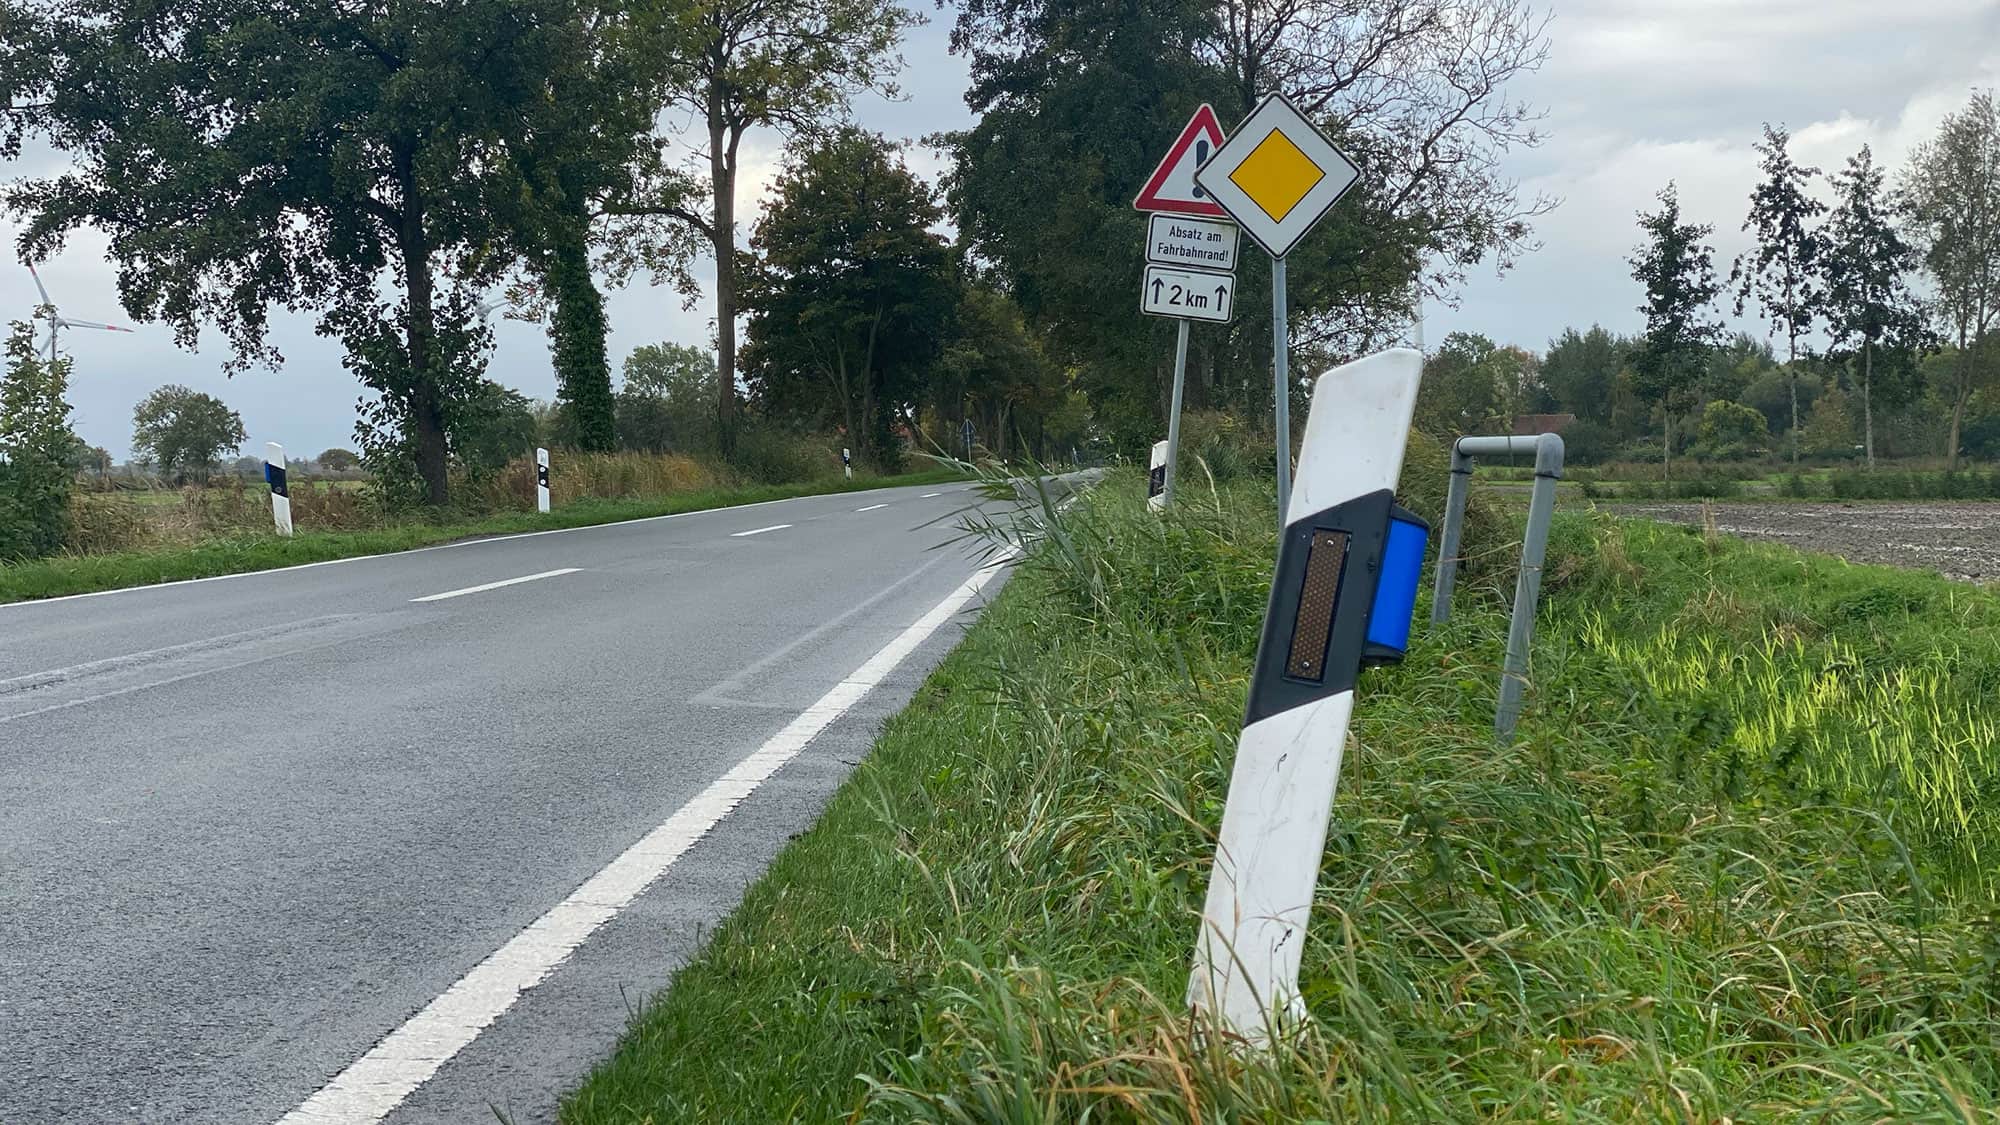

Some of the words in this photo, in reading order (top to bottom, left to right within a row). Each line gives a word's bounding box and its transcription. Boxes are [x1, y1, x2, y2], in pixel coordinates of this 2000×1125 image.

[1169, 225, 1203, 240] Absatz
[1206, 232, 1222, 243] am
[1157, 242, 1229, 262] Fahrbahnrand!
[1169, 284, 1182, 305] 2
[1185, 289, 1208, 308] km
